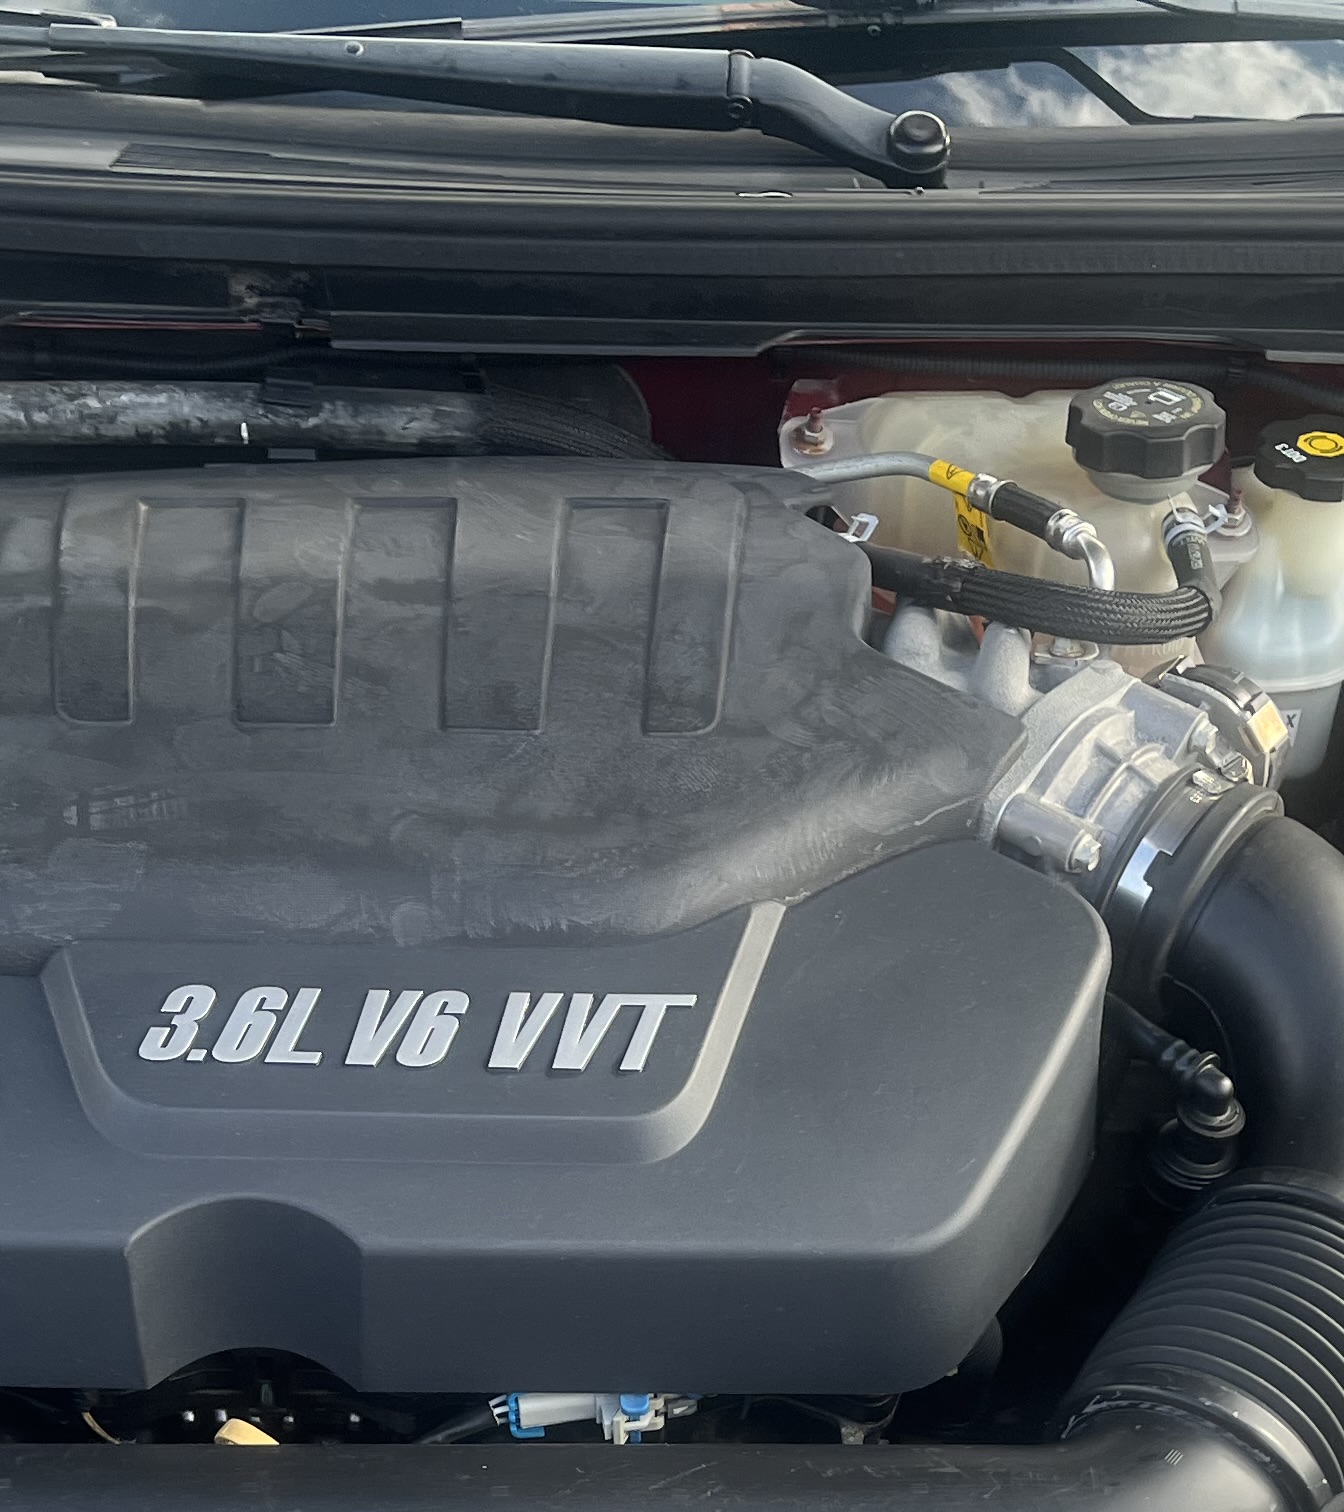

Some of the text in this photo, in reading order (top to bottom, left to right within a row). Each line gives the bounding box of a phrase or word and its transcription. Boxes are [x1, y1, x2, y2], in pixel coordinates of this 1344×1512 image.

[139, 985, 697, 1072] 3.6L V6 VVT
